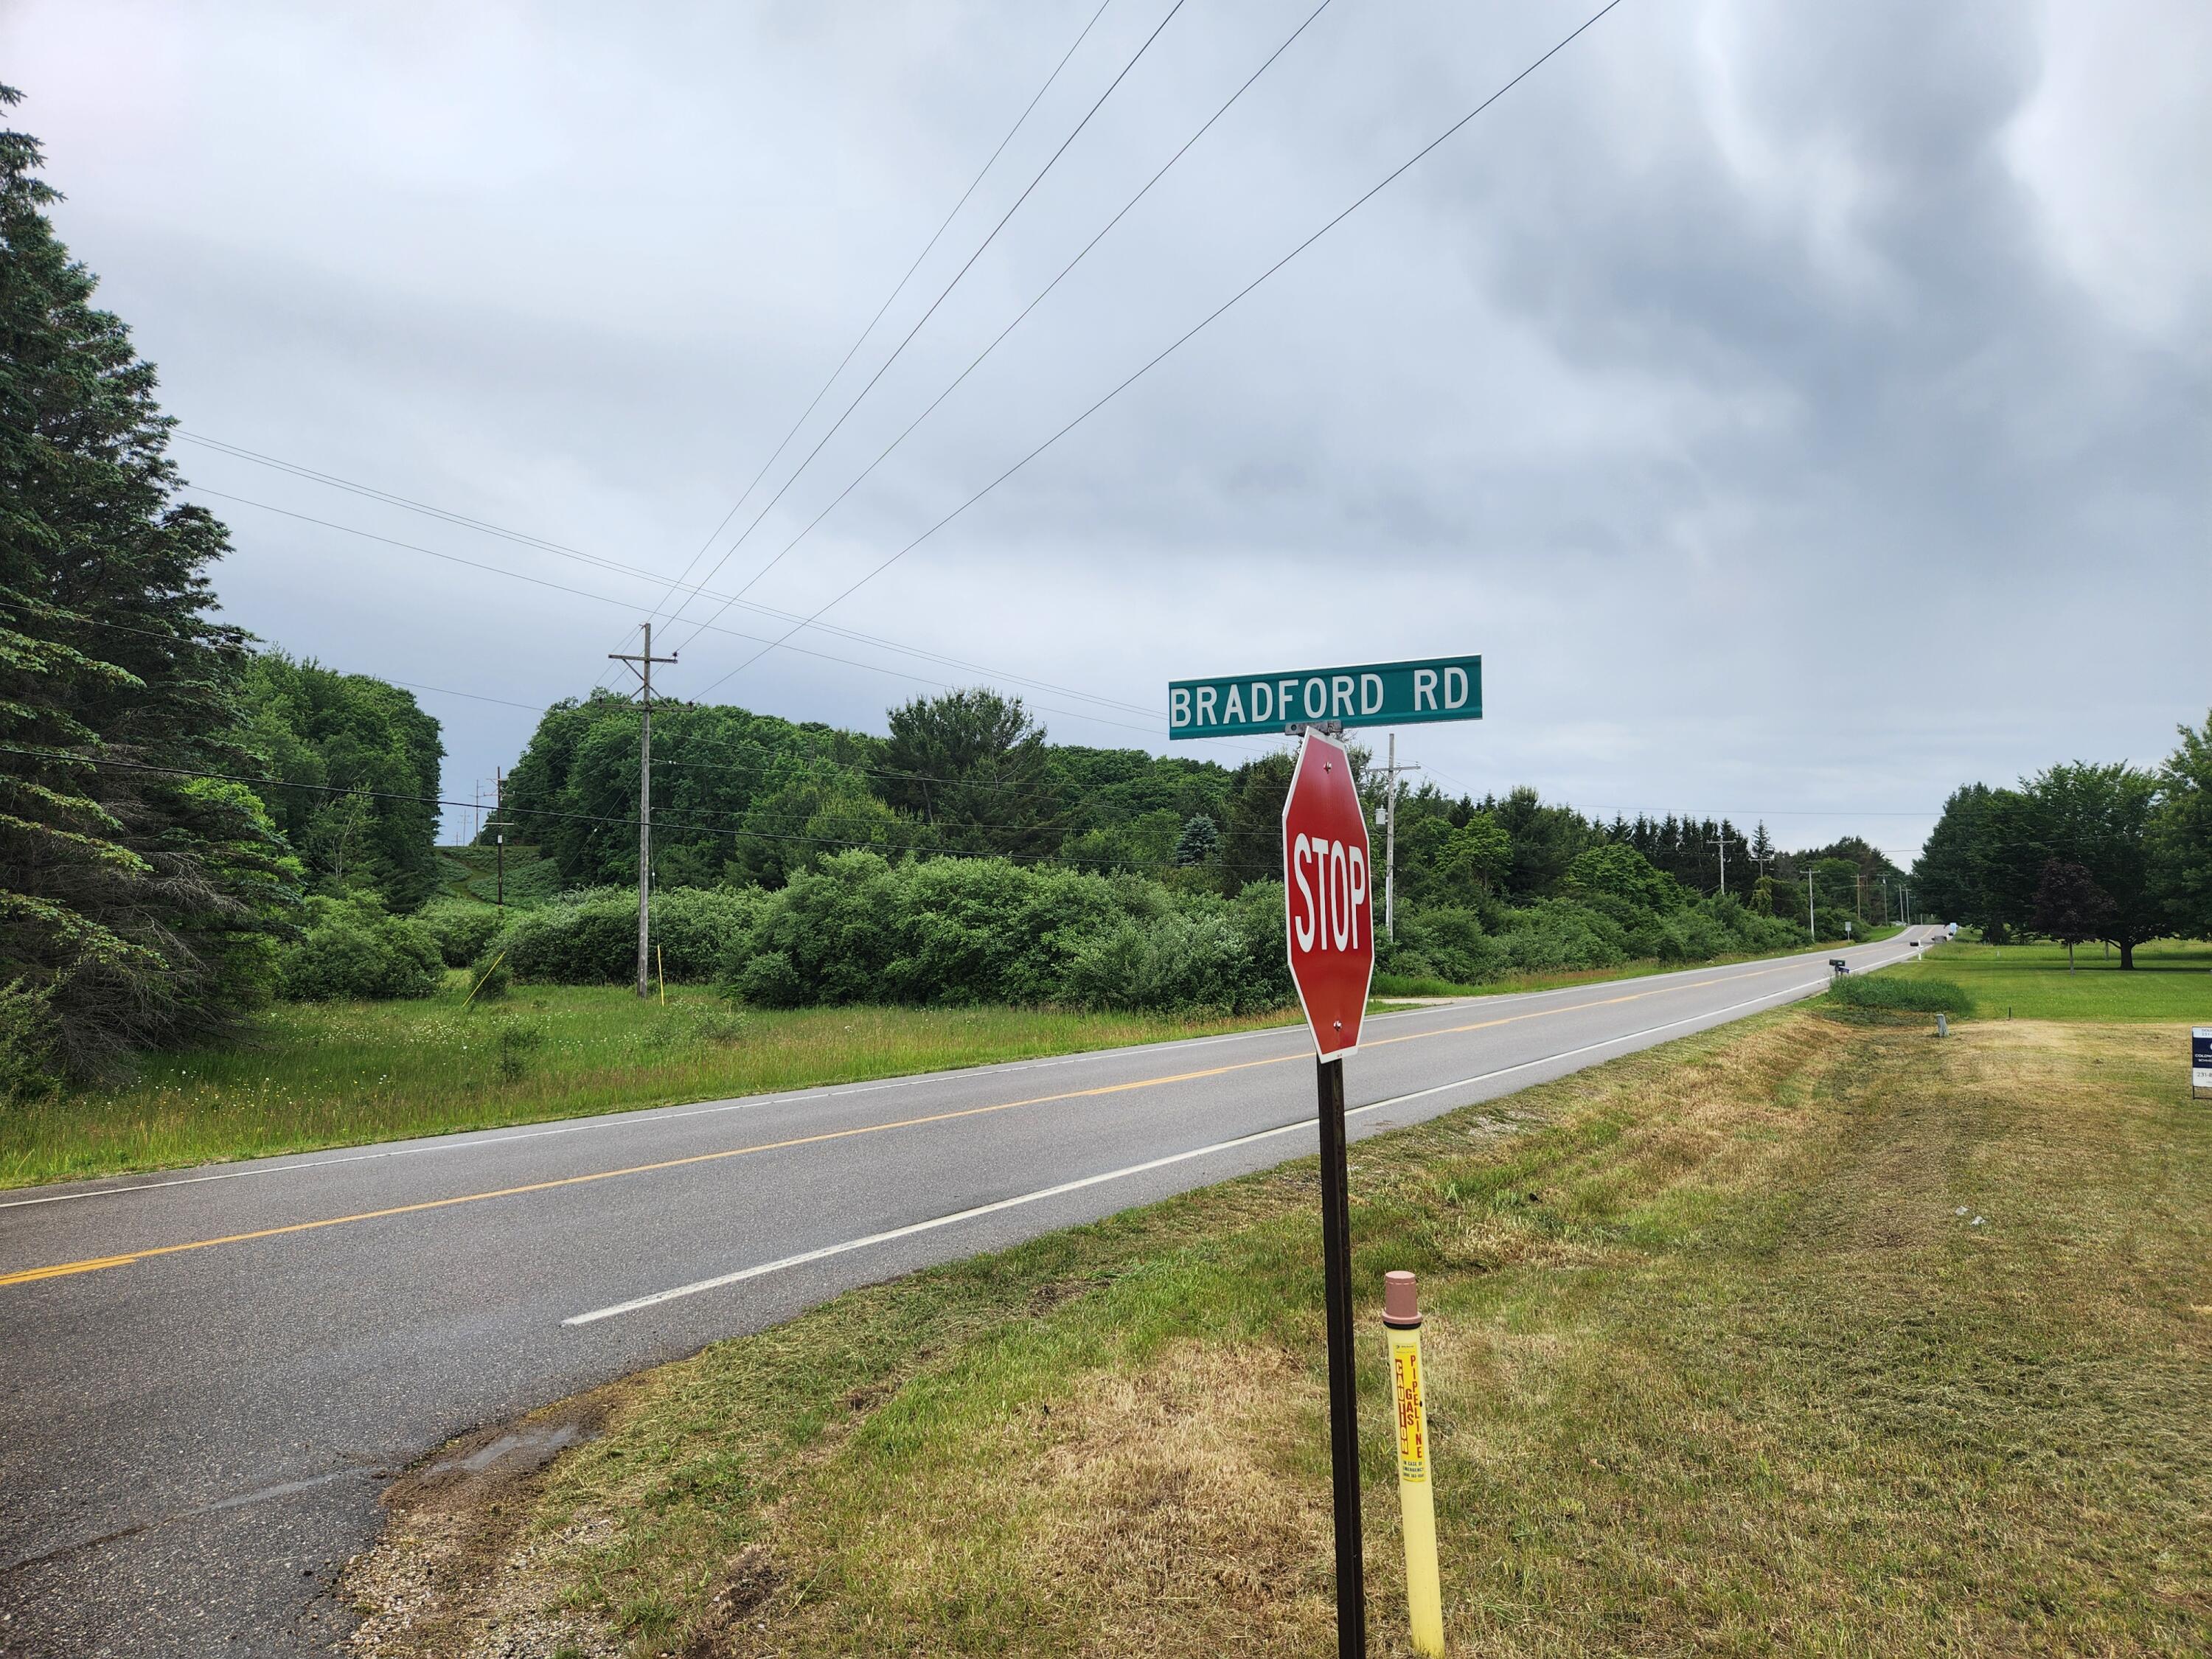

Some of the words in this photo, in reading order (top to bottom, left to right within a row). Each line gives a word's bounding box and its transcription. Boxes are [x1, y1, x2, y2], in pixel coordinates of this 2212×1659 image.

[1171, 674, 1384, 728] BRADFORD
[1413, 667, 1469, 712] RD
[1294, 832, 1365, 953] STOP
[1396, 1360, 1408, 1455] CAUTION
[1405, 1388, 1413, 1425] GAS
[1411, 1355, 1422, 1458] PIPELINE
